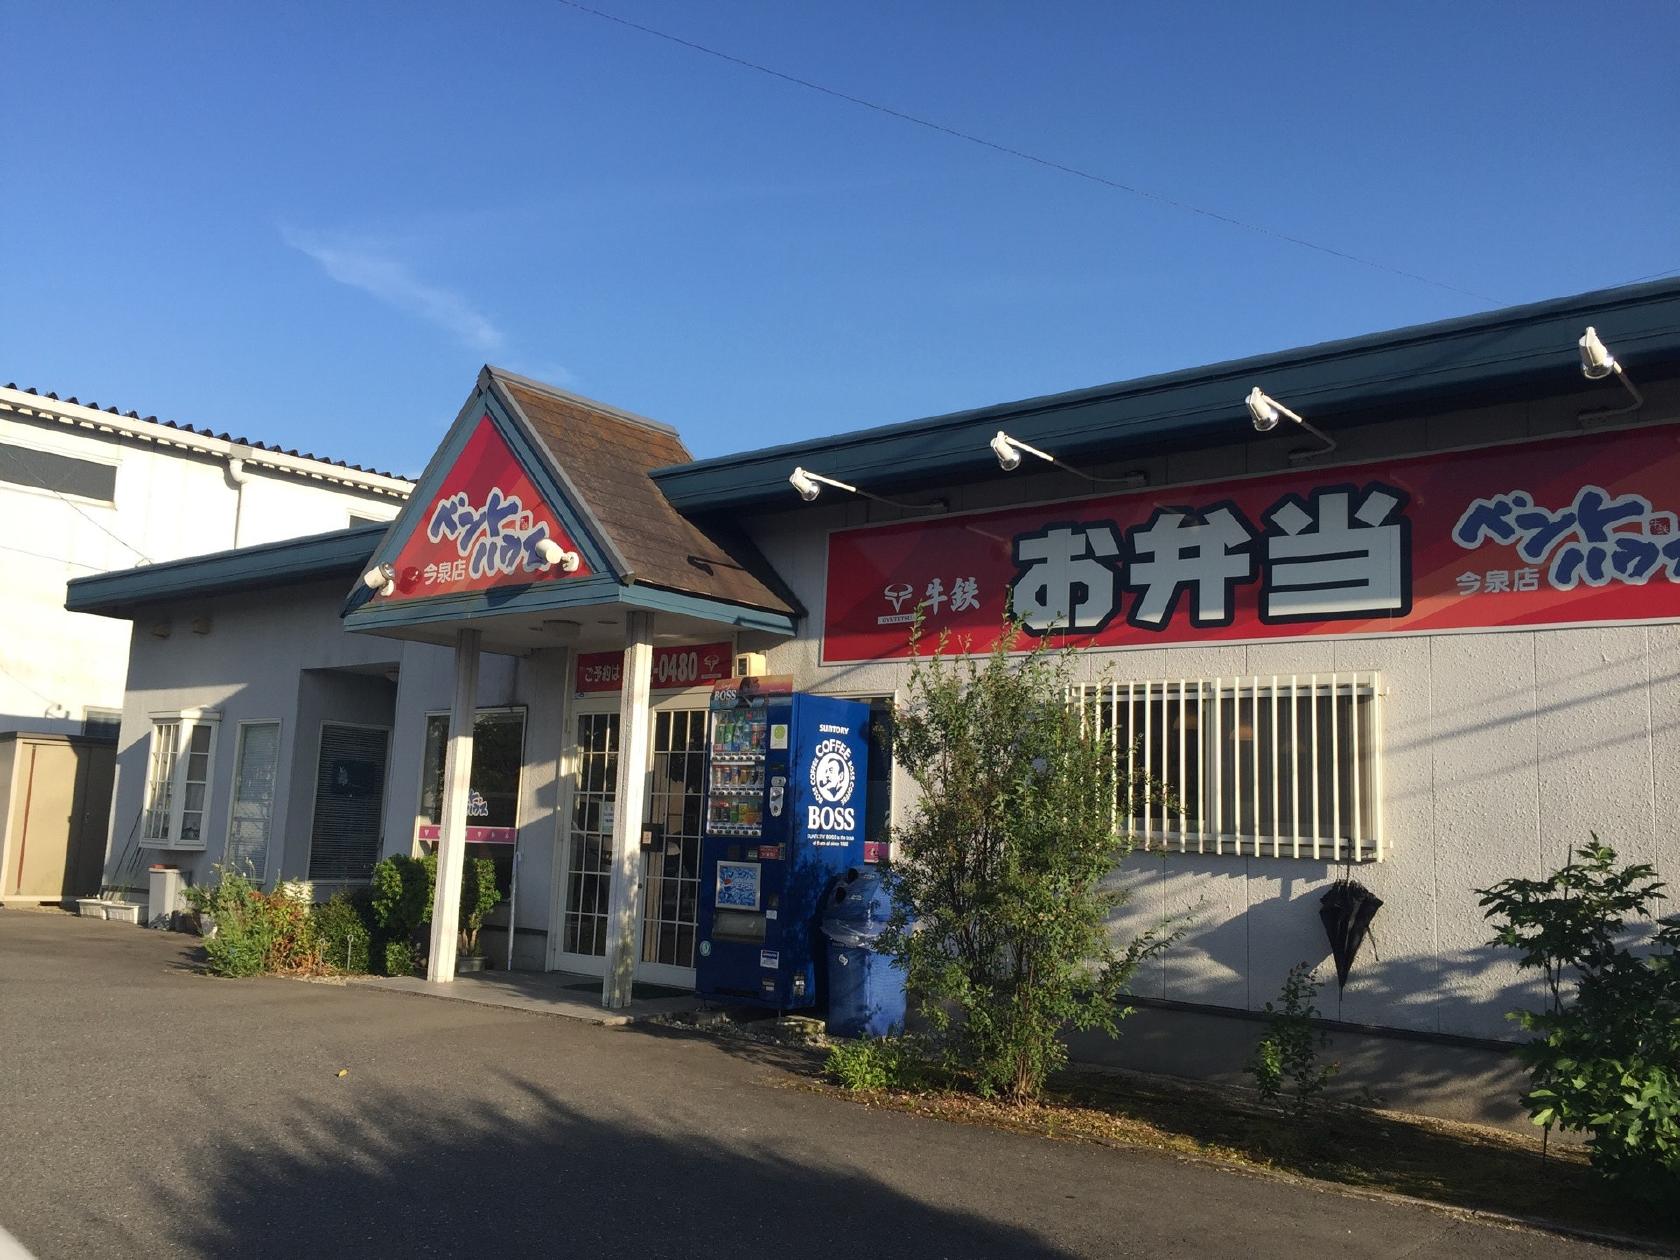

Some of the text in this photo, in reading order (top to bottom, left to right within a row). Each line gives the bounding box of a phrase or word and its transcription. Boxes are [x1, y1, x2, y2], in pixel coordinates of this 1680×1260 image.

[424, 559, 466, 584] 今泉店
[1011, 481, 1412, 638] お弁当
[1456, 567, 1539, 595] 今泉店
[921, 577, 980, 615] 牛鉄
[714, 690, 737, 701] BOSS
[819, 724, 849, 734] SUNTORY
[815, 738, 852, 761] COFFEE
[808, 805, 855, 831] BOSS
